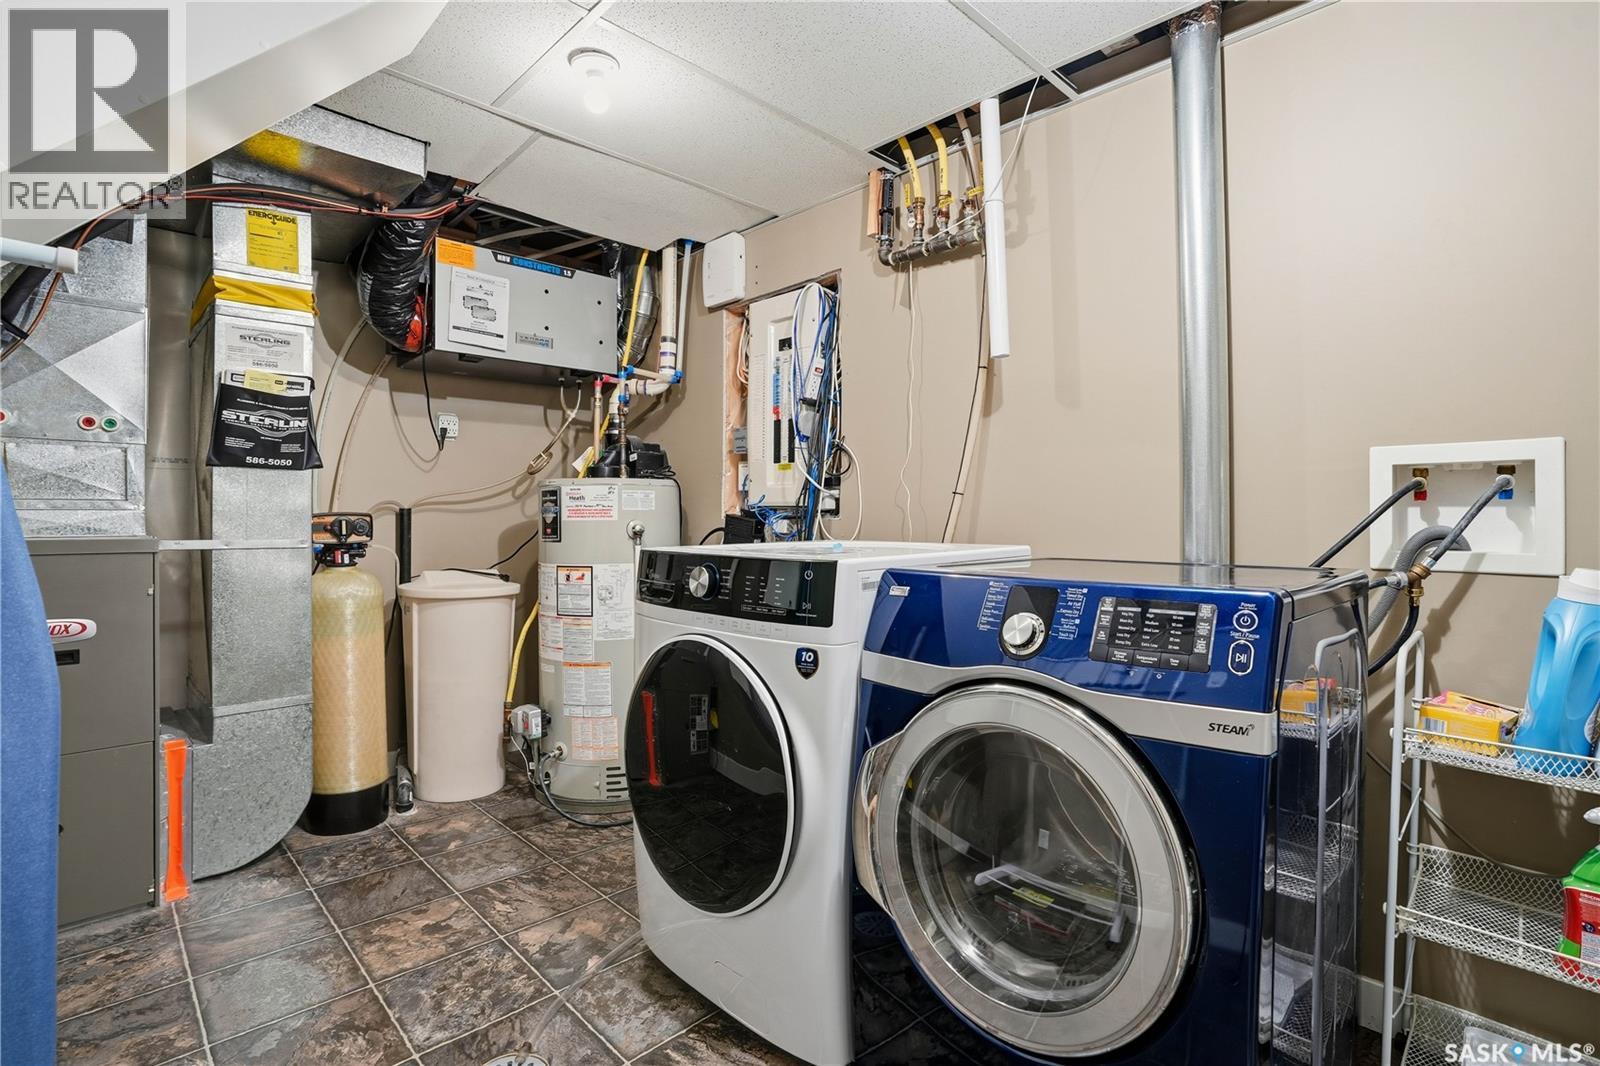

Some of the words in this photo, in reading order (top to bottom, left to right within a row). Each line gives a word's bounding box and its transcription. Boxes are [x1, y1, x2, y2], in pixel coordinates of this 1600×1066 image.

[248, 209, 297, 225] ENERGYGUIDE
[239, 334, 291, 346] STERLING
[221, 409, 308, 428] STERLIN
[246, 456, 292, 466] 586-5050
[801, 651, 814, 662] 10
[1208, 722, 1249, 736] STEAM
